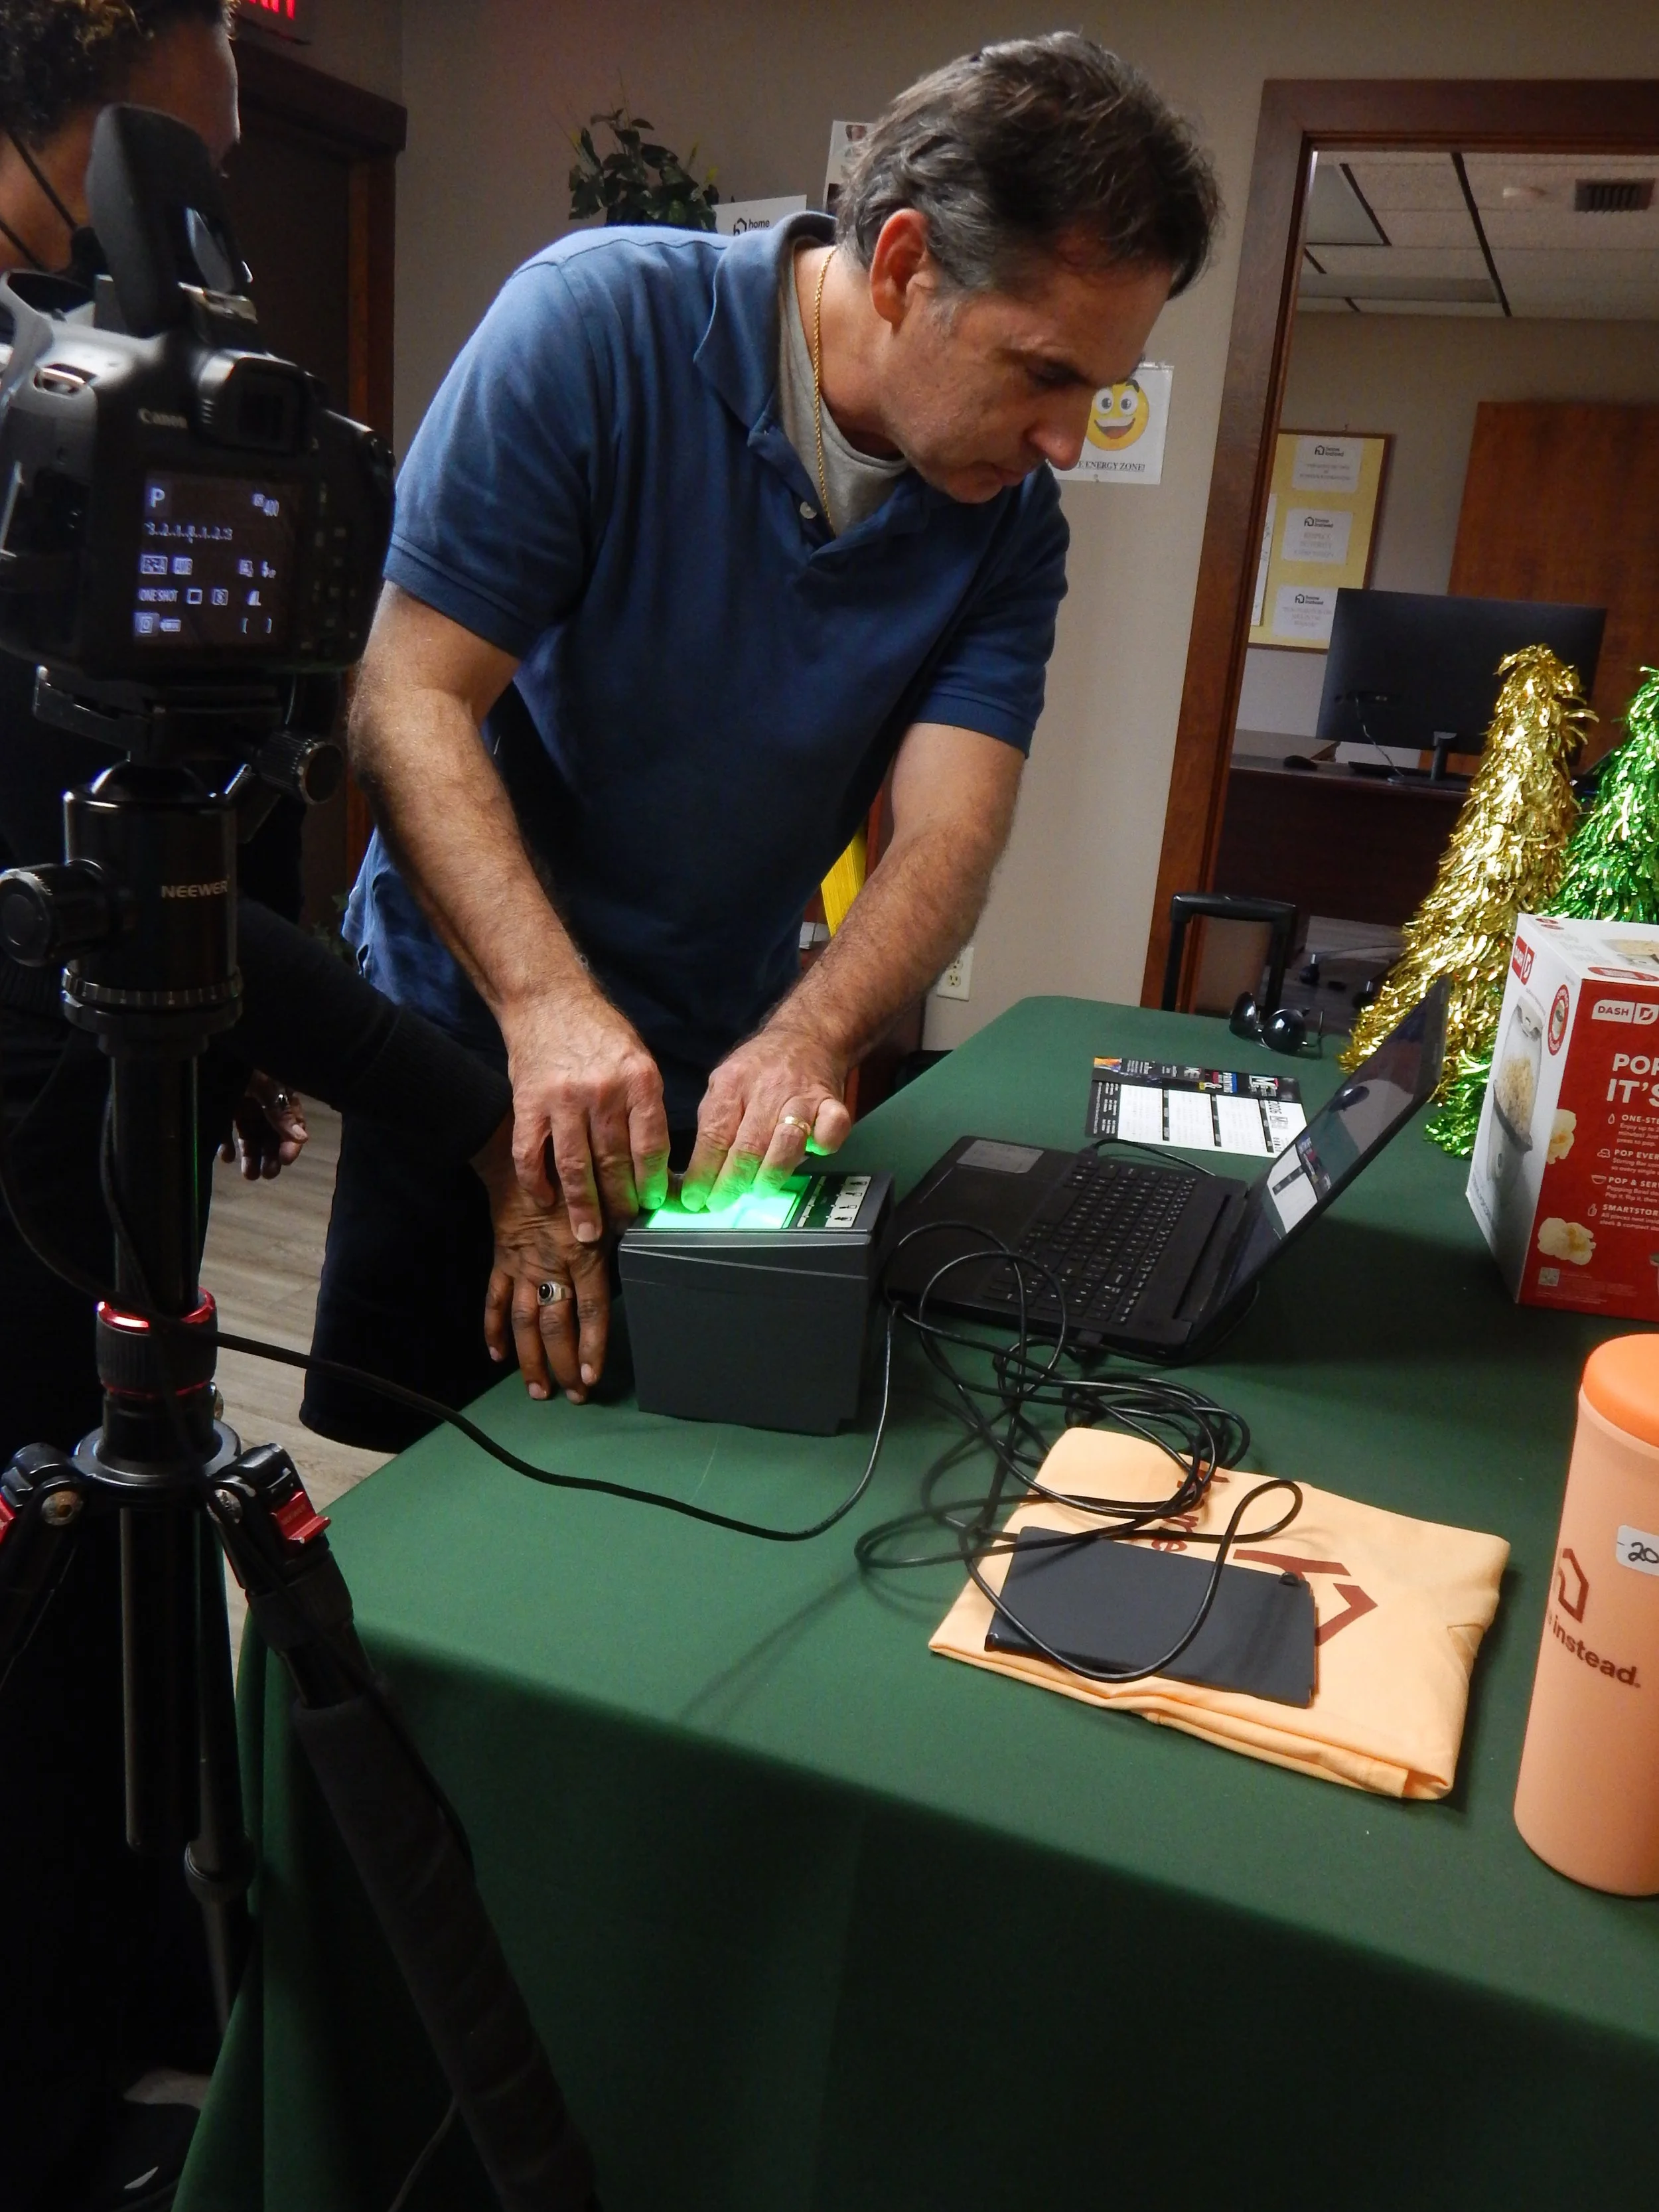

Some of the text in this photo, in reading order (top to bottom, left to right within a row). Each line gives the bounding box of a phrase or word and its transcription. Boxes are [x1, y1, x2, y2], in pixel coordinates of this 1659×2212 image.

[749, 219, 770, 229] home
[137, 407, 187, 428] Canon
[1085, 461, 1118, 470] ENERGY
[1119, 462, 1145, 472] ZONE!
[151, 488, 165, 508] P
[139, 588, 179, 603] ONE SHOT
[161, 879, 228, 899] NEEWER
[1598, 1006, 1629, 1016] DASH
[1268, 1101, 1283, 1114] 2026
[1552, 1615, 1641, 1688] instead.
